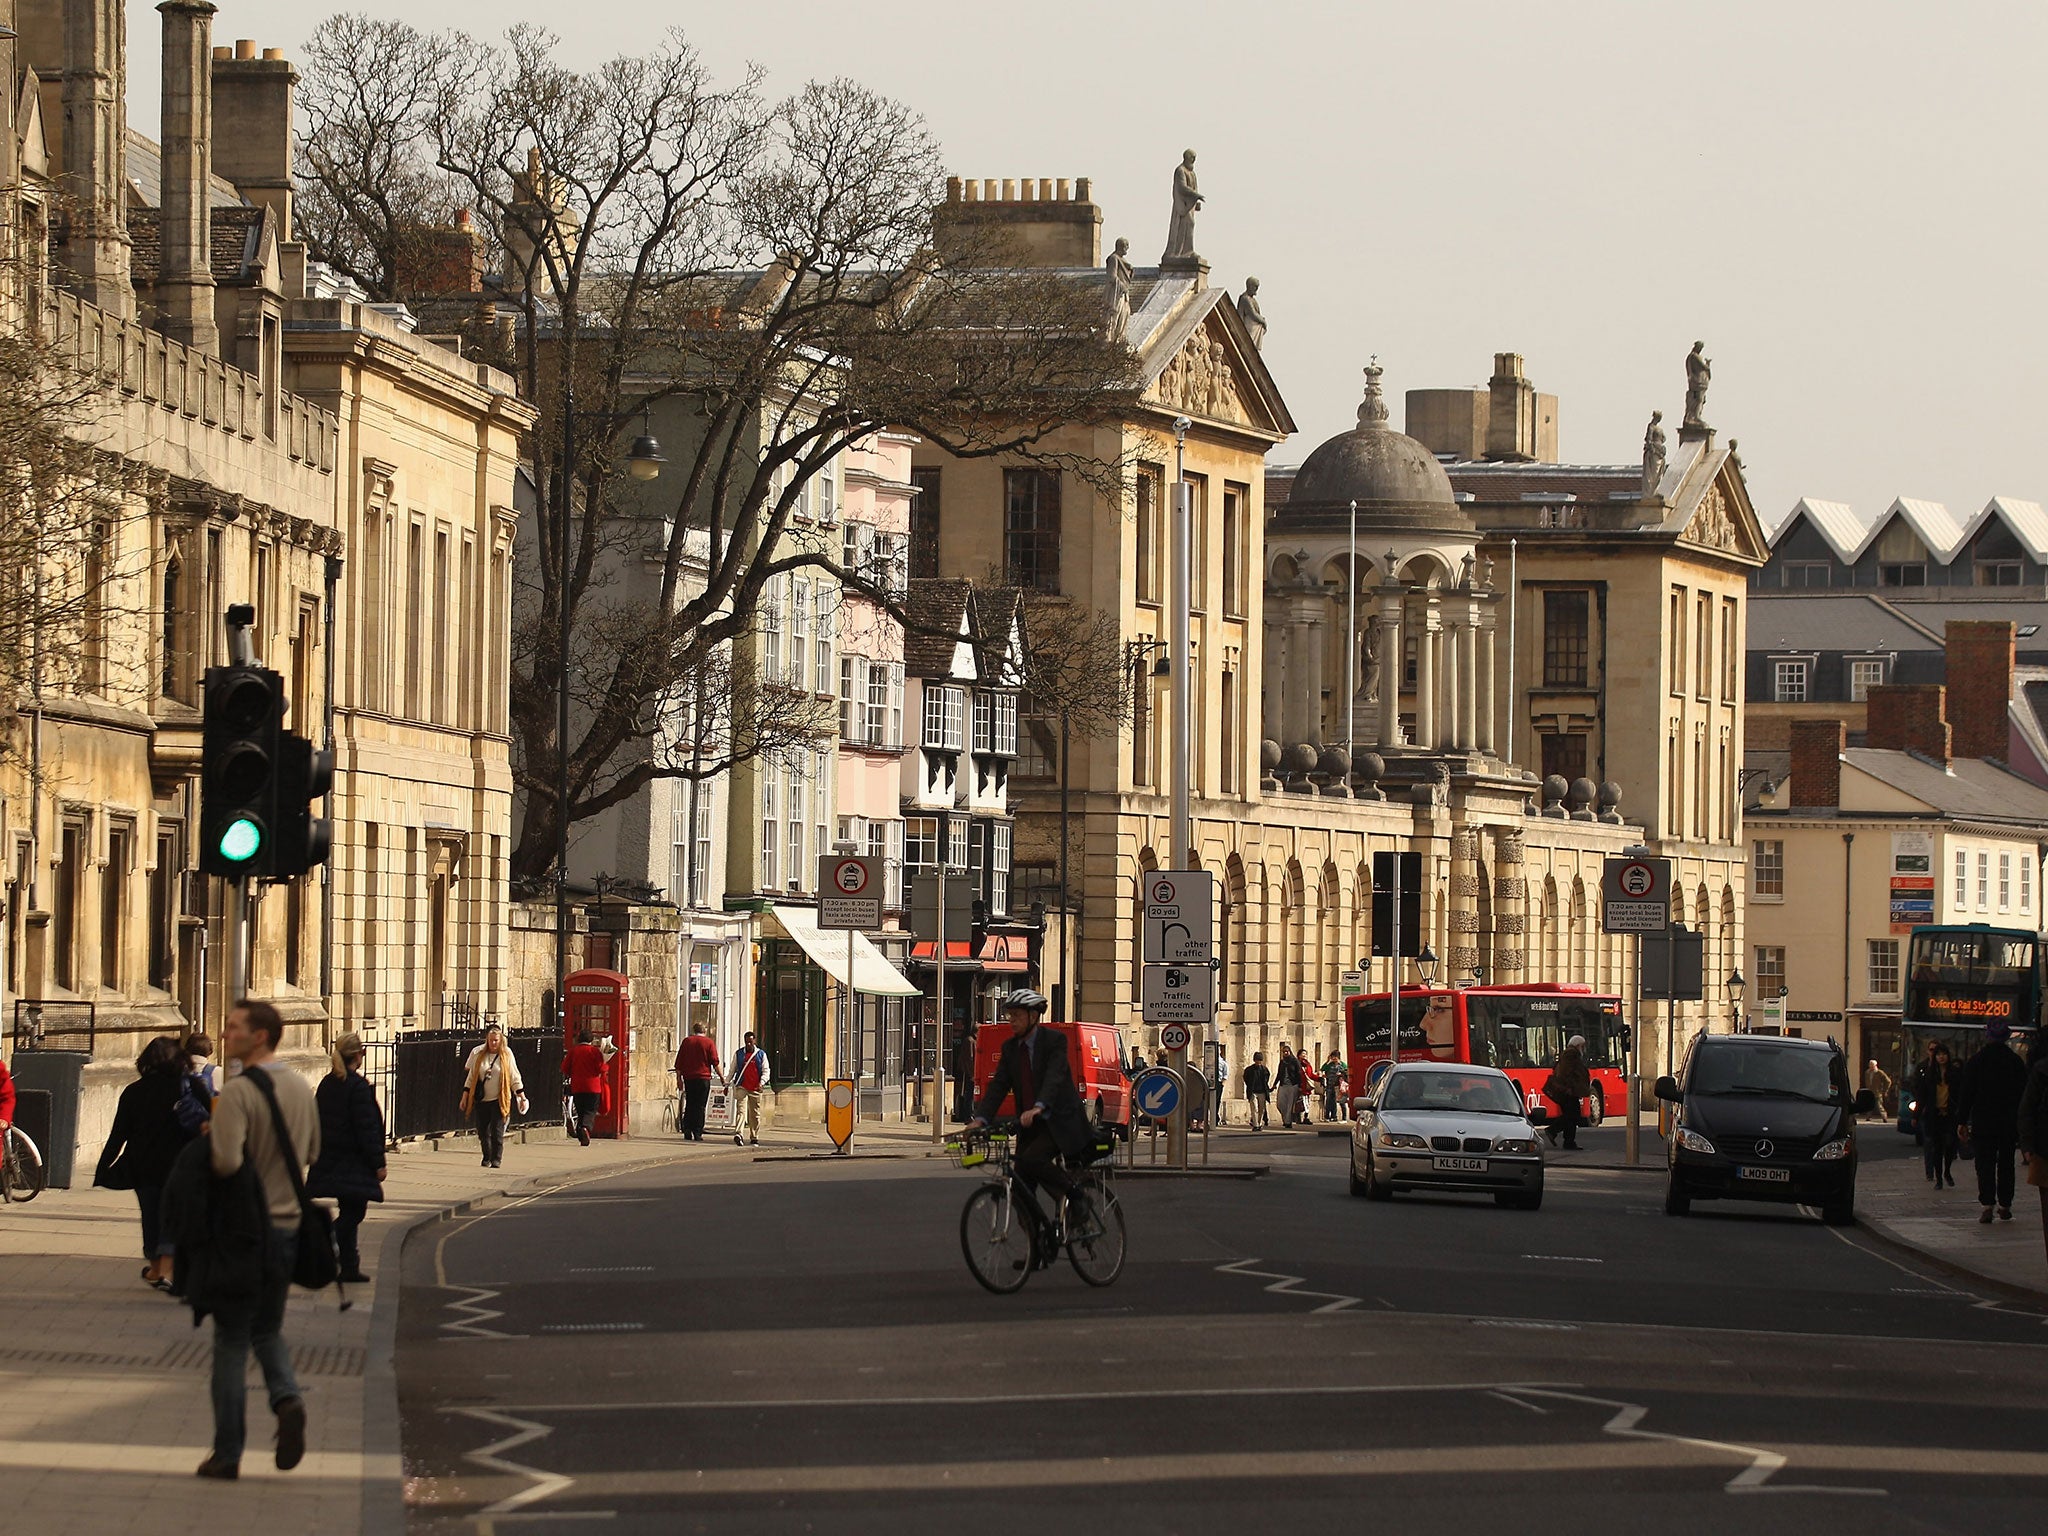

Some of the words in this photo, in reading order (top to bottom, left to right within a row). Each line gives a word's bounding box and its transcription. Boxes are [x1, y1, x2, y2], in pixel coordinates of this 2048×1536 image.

[1209, 959, 1219, 967] K1
[1149, 1001, 1204, 1009] enforcement
[1929, 999, 1956, 1009] Oxford
[1958, 1000, 1971, 1009] Rail
[1973, 1001, 1986, 1010] Stn
[1986, 1001, 2010, 1016] 280
[1165, 1031, 1185, 1043] 20
[1366, 1033, 1376, 1041] no
[1440, 1158, 1460, 1168] KL51
[1463, 1159, 1482, 1169] LGA
[1742, 1168, 1767, 1178] LM09
[1769, 1170, 1788, 1180] OHT
